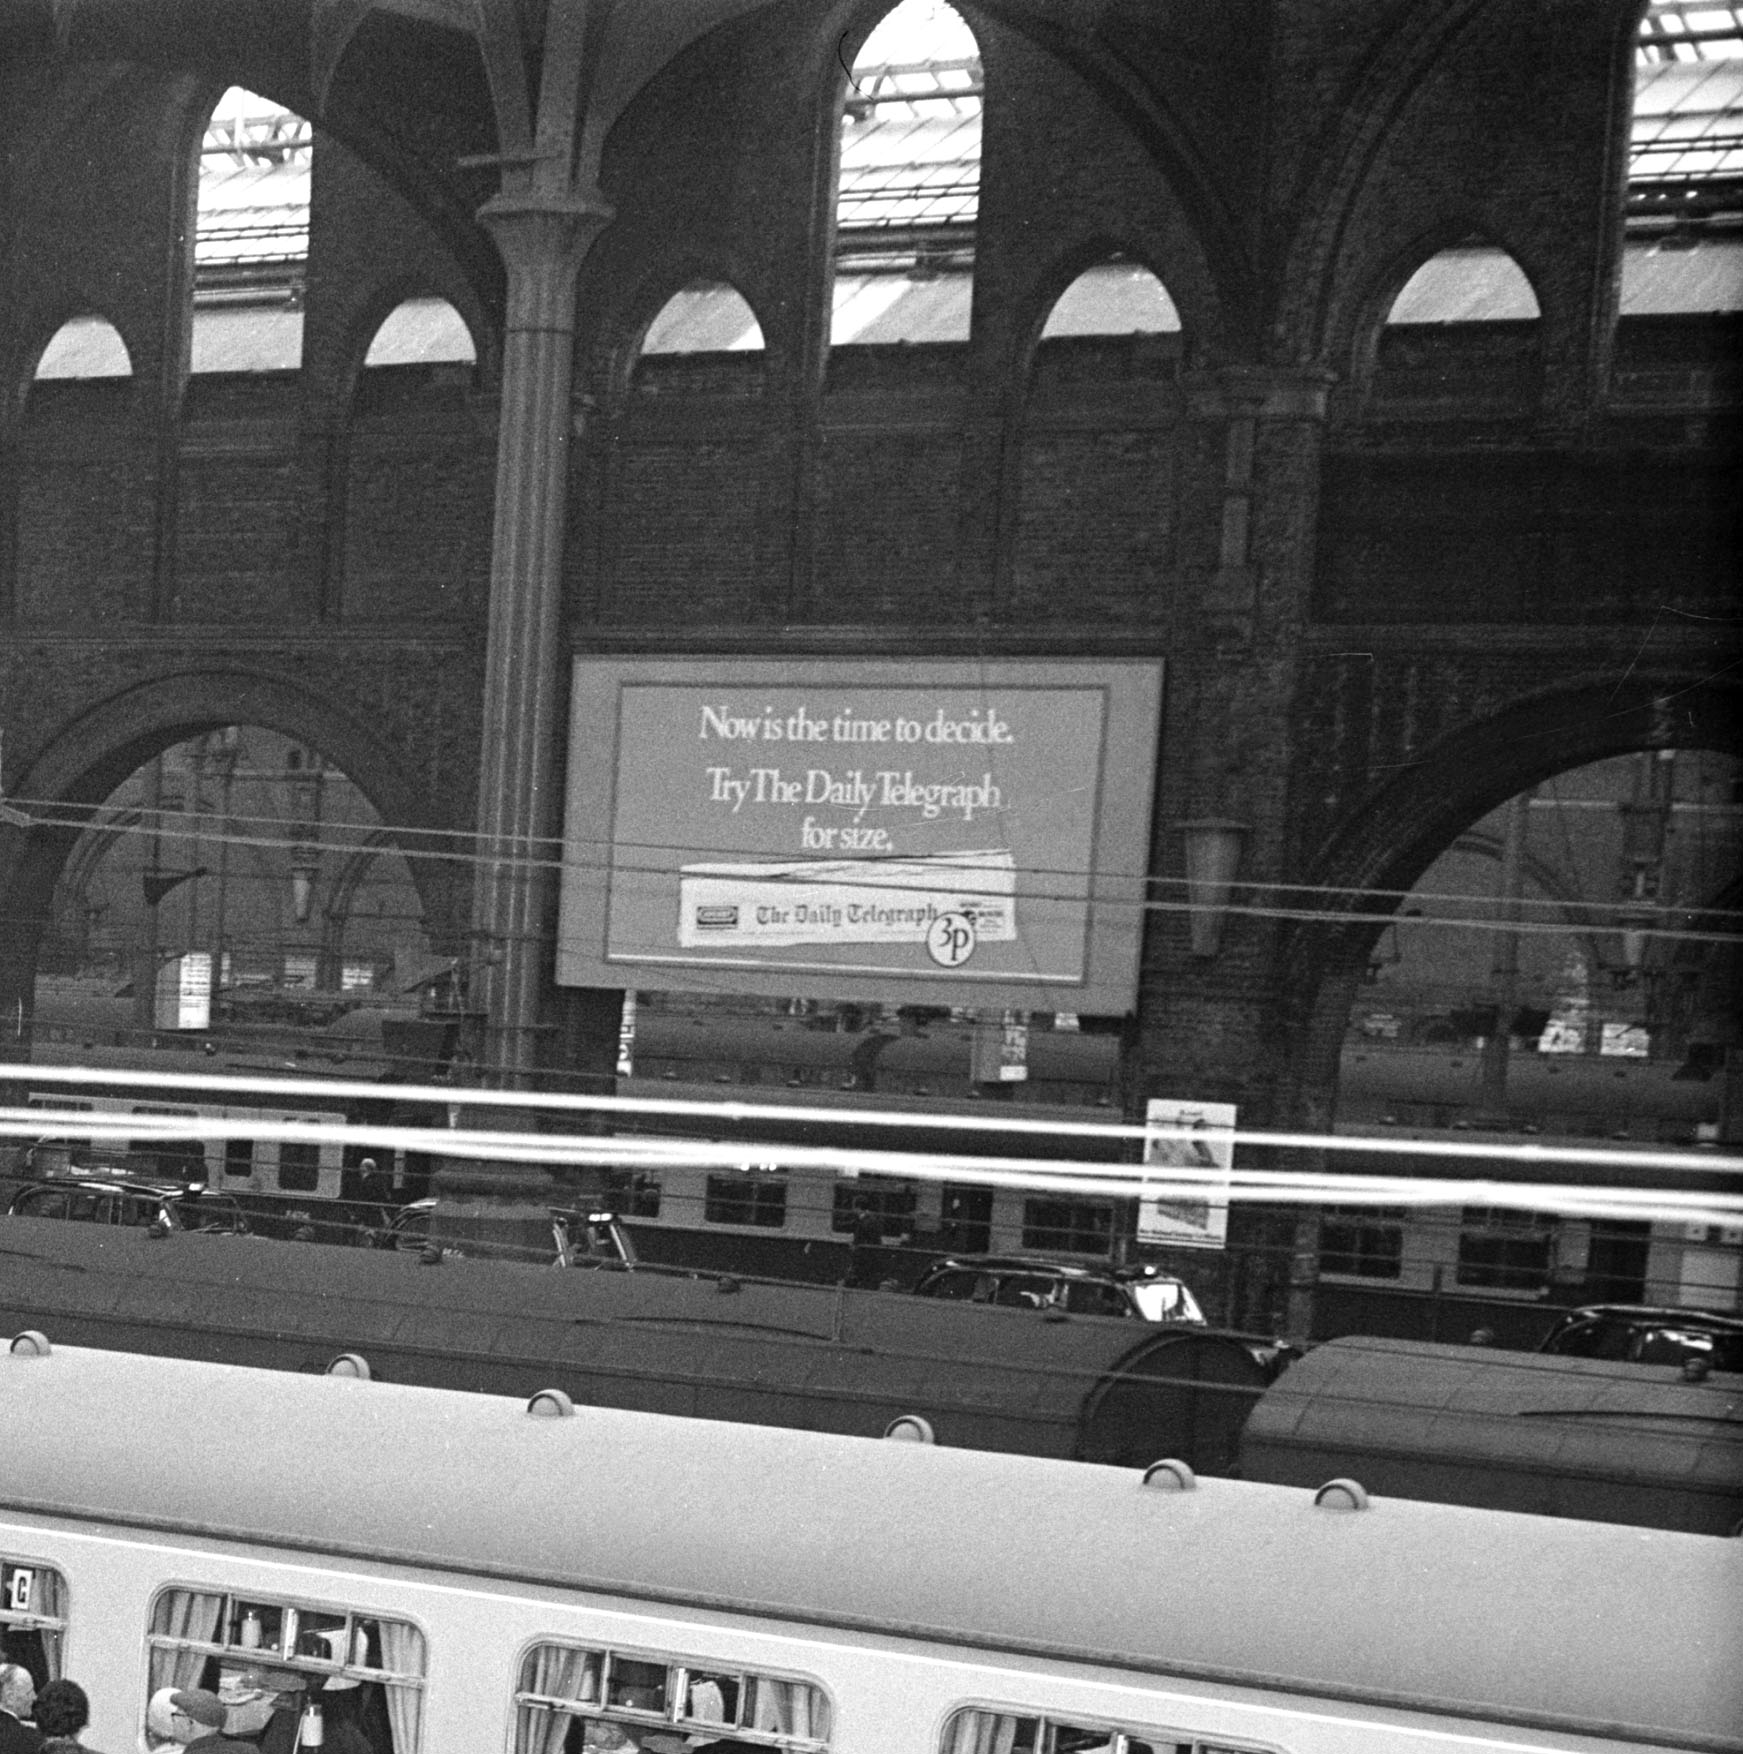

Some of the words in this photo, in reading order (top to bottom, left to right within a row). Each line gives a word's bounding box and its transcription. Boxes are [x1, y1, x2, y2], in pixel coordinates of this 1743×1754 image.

[699, 706, 759, 739] Now
[762, 706, 783, 740] is
[787, 707, 829, 741] the
[833, 709, 890, 742] time
[895, 714, 921, 742] to
[925, 709, 1015, 743] decide.
[707, 767, 750, 812] Try
[750, 768, 802, 803] The
[806, 770, 876, 820] Daily
[876, 772, 1001, 821] Telegraph
[802, 816, 838, 849] for
[756, 905, 790, 926] The
[796, 904, 842, 927] Daily
[847, 903, 940, 927] Telegraph
[938, 917, 969, 962] 3p
